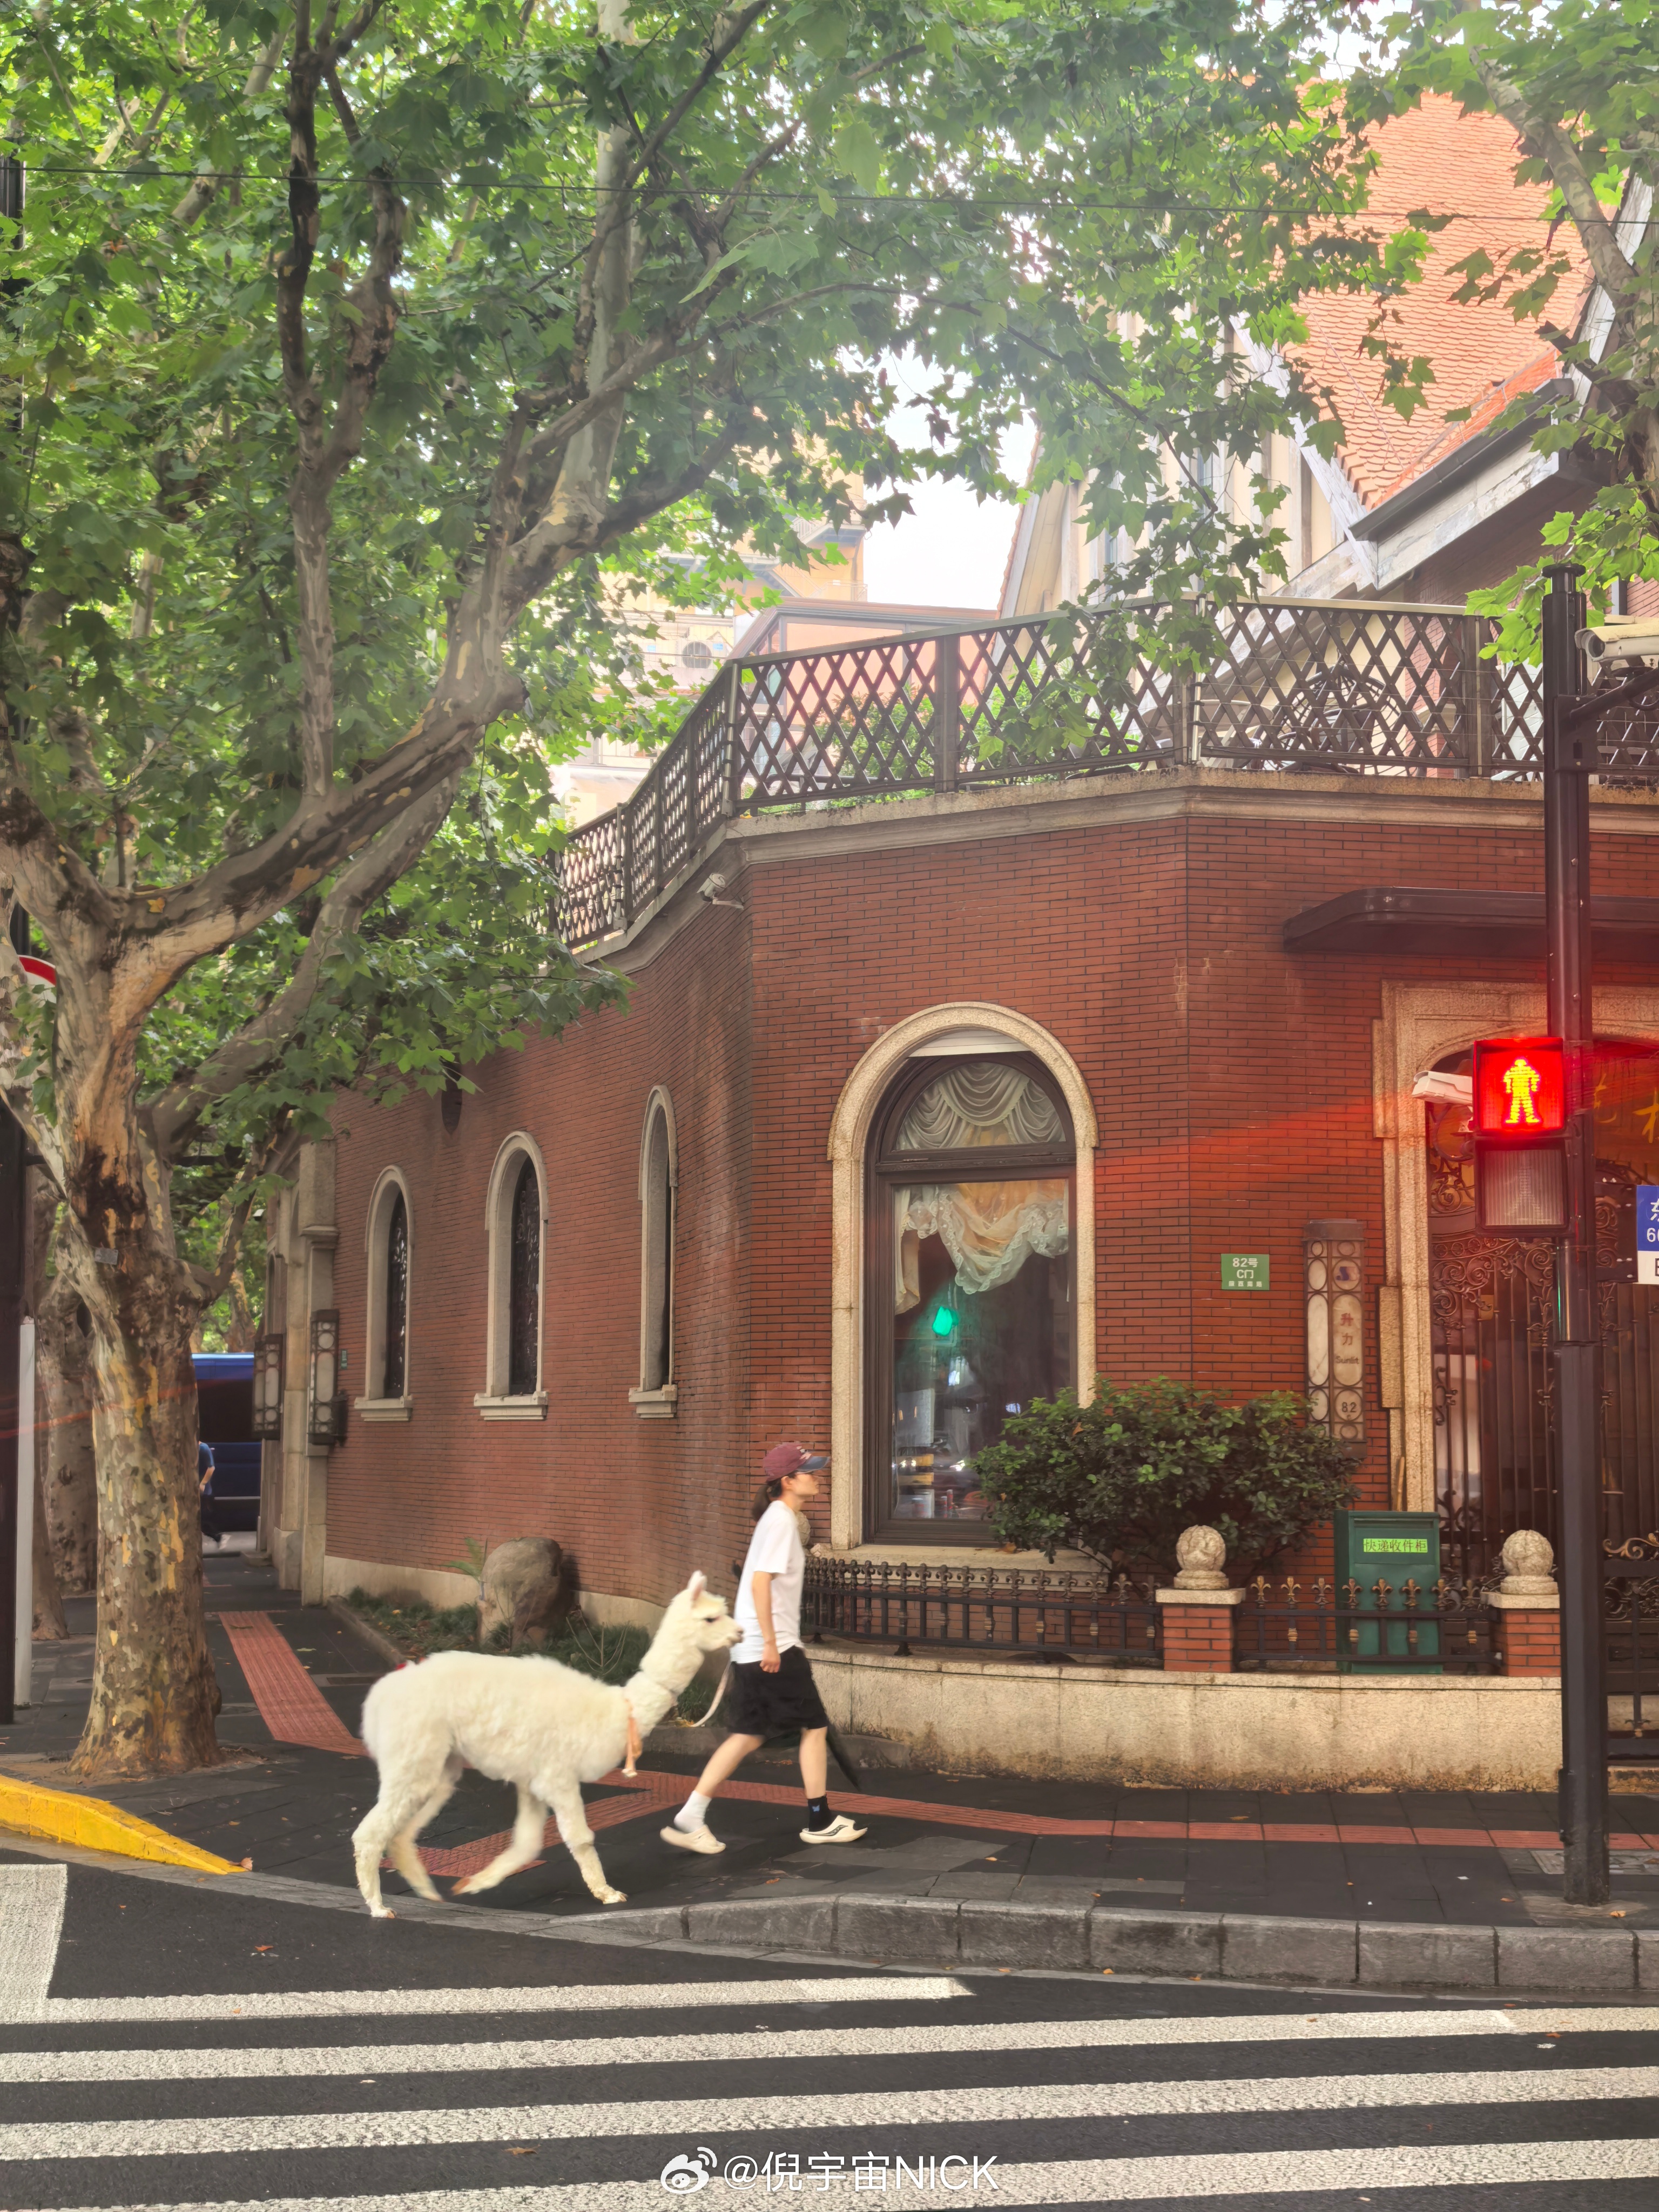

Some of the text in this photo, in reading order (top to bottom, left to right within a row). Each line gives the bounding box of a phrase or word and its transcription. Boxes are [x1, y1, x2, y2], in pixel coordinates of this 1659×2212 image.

[1232, 1257, 1258, 1267] 82号
[1236, 1269, 1254, 1279] C门
[1341, 1401, 1357, 1413] 82
[1364, 1539, 1427, 1552] 快递收件柜
